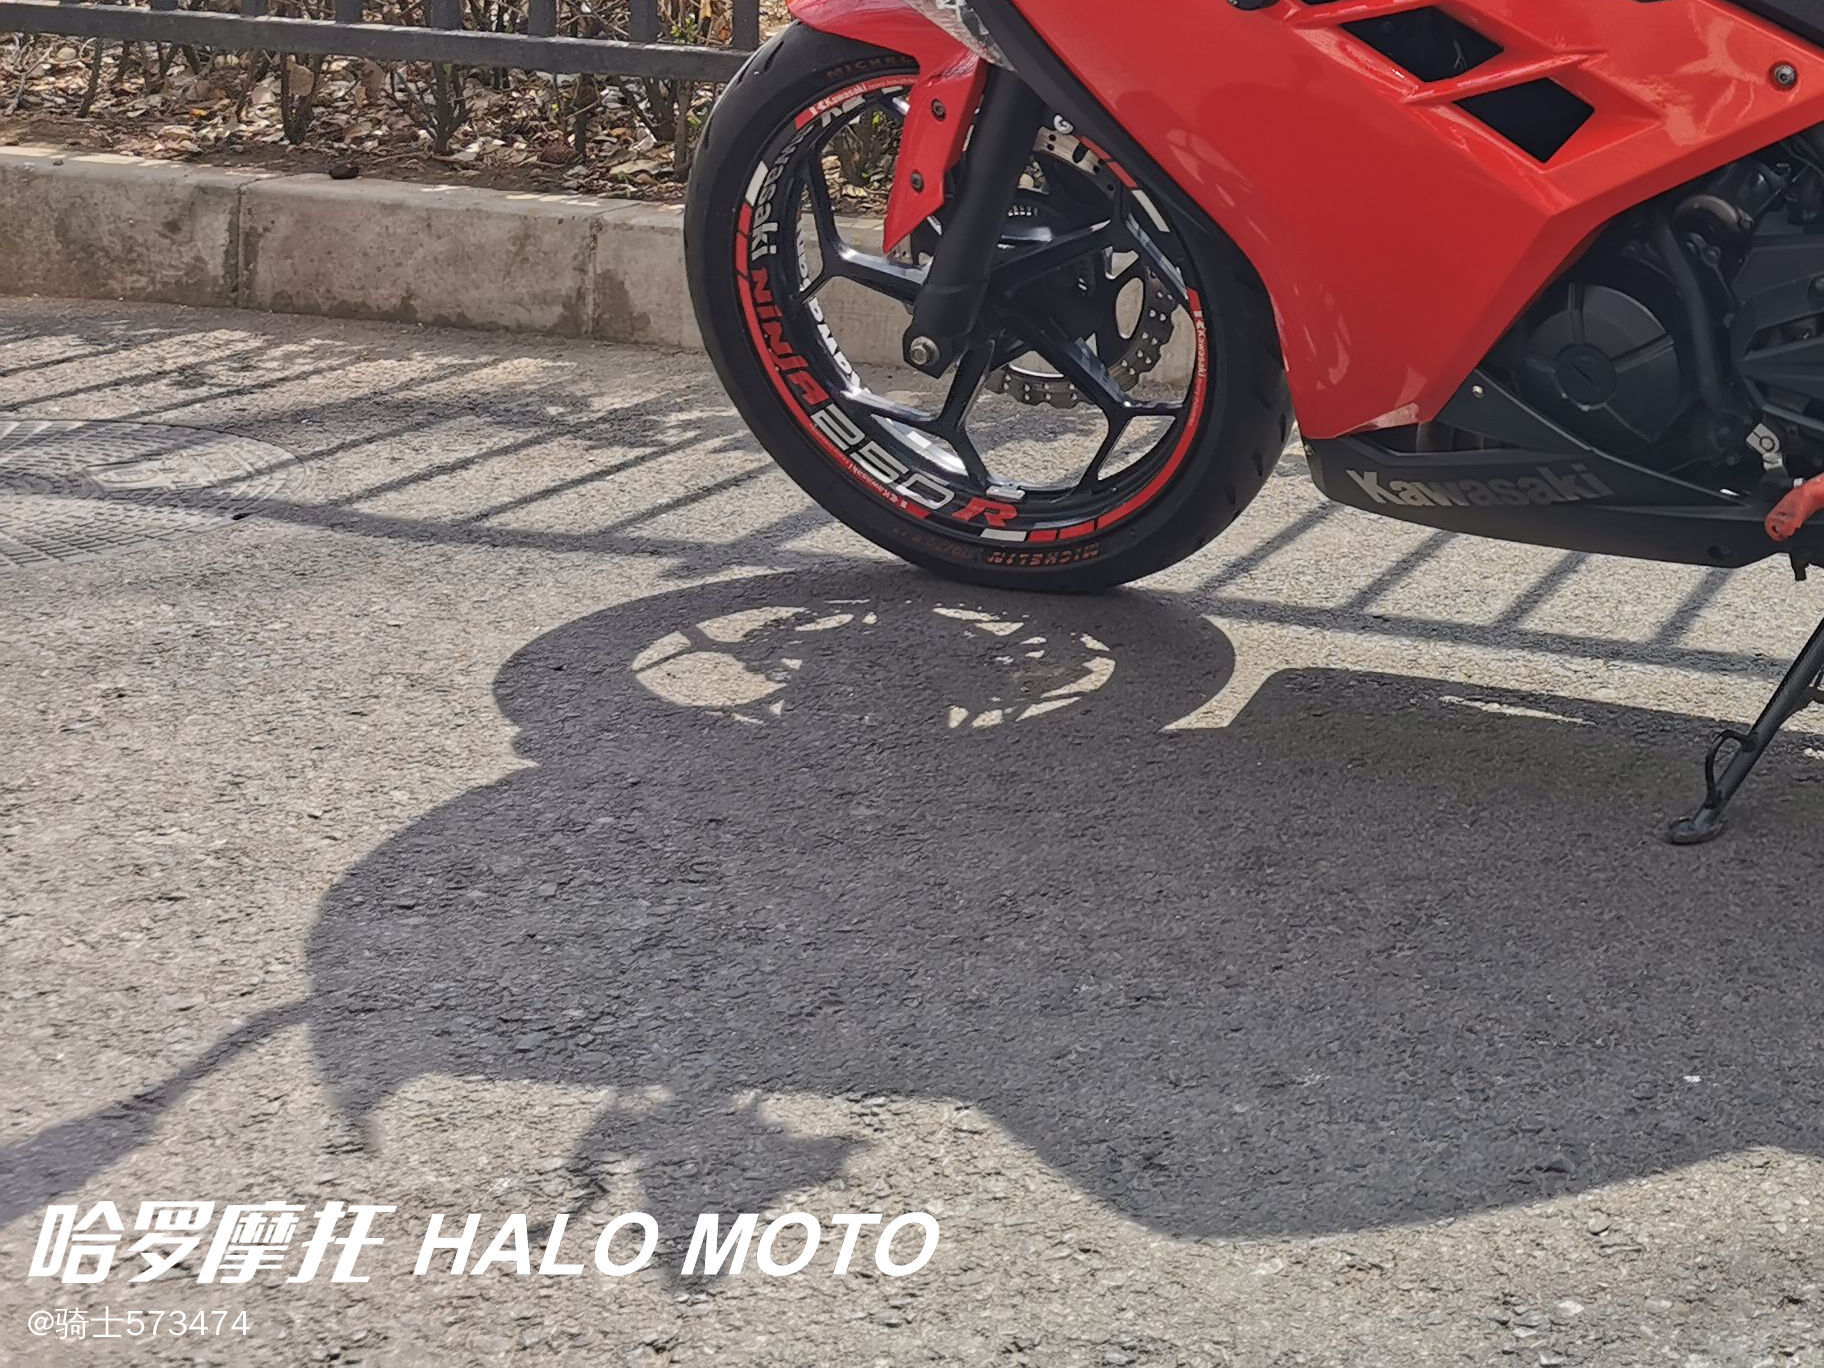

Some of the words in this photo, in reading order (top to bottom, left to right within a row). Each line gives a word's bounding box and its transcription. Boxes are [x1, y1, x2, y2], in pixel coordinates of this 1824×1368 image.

[751, 266, 830, 406] NINJA
[1346, 462, 1614, 508] Kawasaki
[986, 542, 1099, 567] MICHELIN
